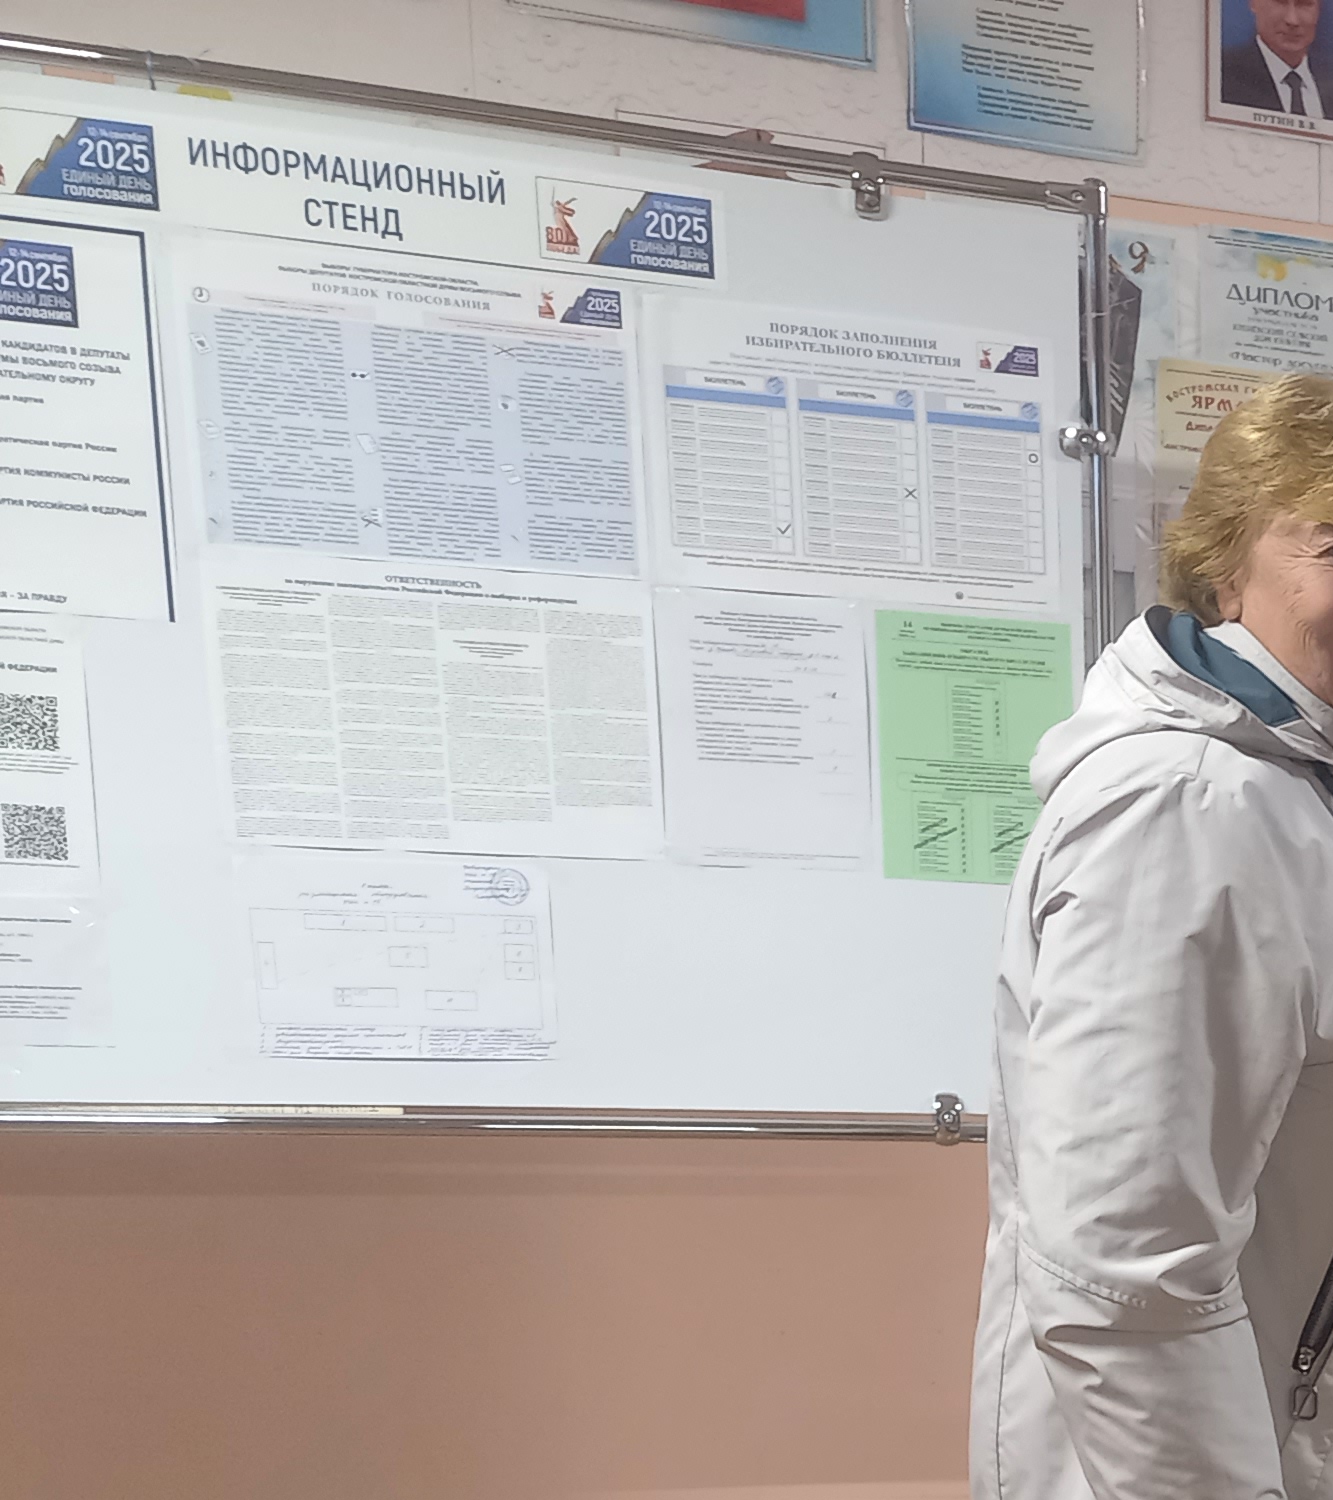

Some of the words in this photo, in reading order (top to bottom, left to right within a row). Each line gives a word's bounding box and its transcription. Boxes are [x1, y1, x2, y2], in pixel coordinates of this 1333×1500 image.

[1253, 112, 1295, 128] ПУТИН
[77, 137, 150, 174] 2025
[61, 168, 116, 187] ЕДИНЫЙ
[117, 175, 153, 191] ДЕНЬ
[188, 136, 506, 206] ИНФОРМАЦИОННЫЙ
[63, 183, 154, 205] голосования
[304, 197, 403, 241] СТЕНД
[644, 210, 708, 244] 2025
[629, 239, 678, 257] ЕДИНЫЙ
[678, 246, 709, 260] ДЕНЬ
[630, 253, 710, 273] голосования
[0, 257, 70, 292] 2025
[37, 294, 72, 309] ДЕНЬ
[312, 282, 379, 298] ПОРЯДОК
[387, 290, 491, 311] ГОЛОСОВАНИЯ
[586, 297, 619, 314] 2025
[1226, 283, 1333, 313] ДИПЛОМ
[769, 322, 838, 340] ПОРЯДОК
[841, 330, 938, 350] ЗАПОЛНЕНИЯ
[80, 347, 130, 361] ДЕПУТАТЫ
[745, 335, 873, 359] ИЗБИРАТЕЛЬНОГО
[876, 350, 962, 368] БЮЛЛЕТЕНЯ
[22, 356, 76, 370] ВОСЬМОГО
[79, 362, 122, 375] СОЗЫВА
[59, 375, 96, 387] ОКРУГУ
[384, 575, 482, 589] ОТВЕТСТВЕННОСТЬ
